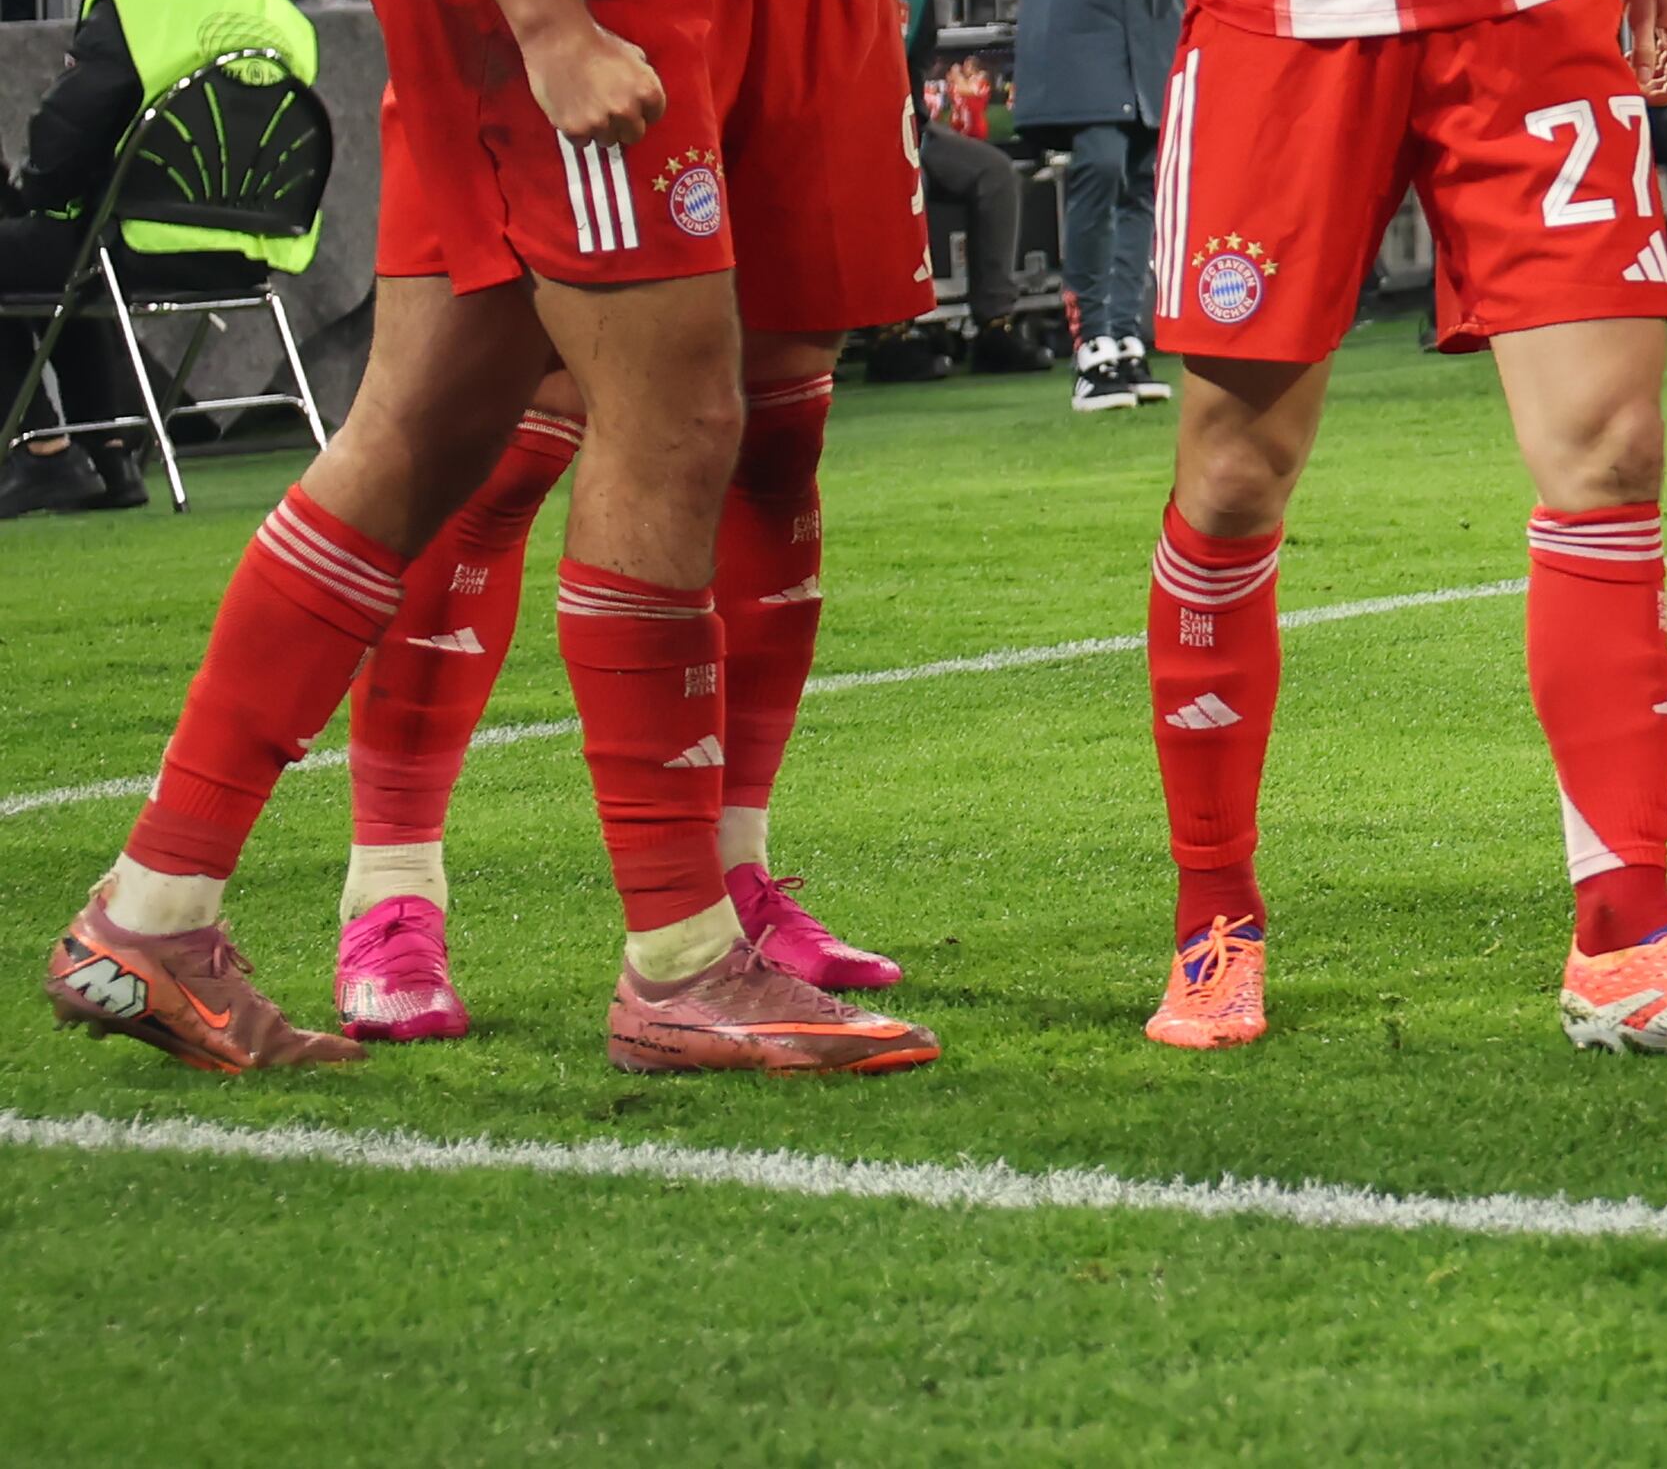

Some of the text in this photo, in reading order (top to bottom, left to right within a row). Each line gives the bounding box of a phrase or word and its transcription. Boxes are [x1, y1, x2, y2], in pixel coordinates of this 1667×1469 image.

[1524, 94, 1654, 229] 27
[1204, 259, 1257, 288] FC BAYERN
[1180, 619, 1214, 635] SAN
[1179, 632, 1214, 648] MIA
